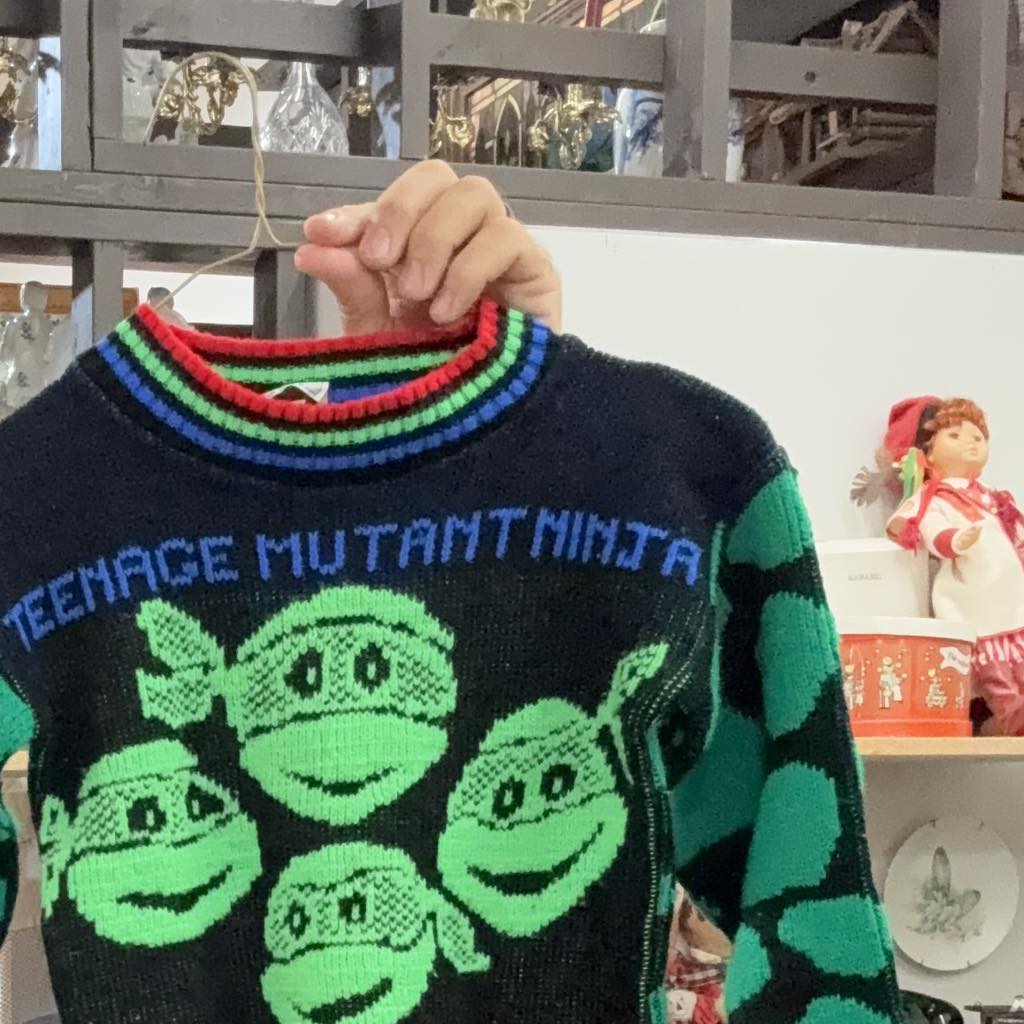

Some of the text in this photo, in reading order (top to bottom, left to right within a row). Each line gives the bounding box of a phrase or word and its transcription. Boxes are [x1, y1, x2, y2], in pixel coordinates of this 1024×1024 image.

[1, 506, 703, 653] TEENAGE MUTANT NINJA
